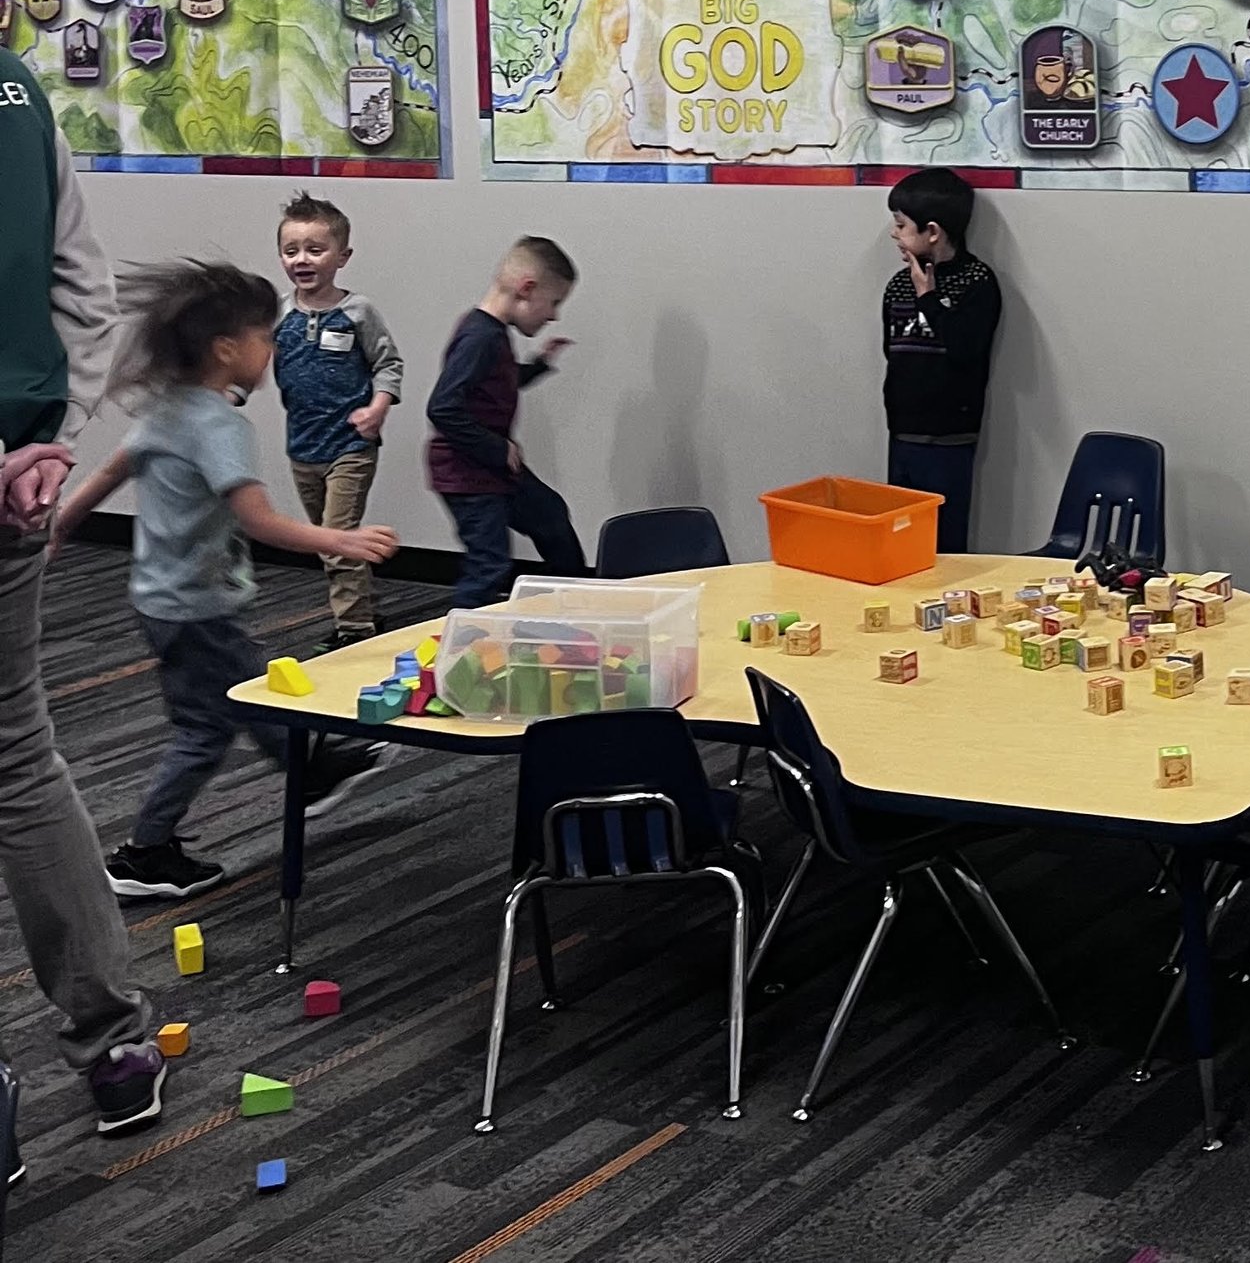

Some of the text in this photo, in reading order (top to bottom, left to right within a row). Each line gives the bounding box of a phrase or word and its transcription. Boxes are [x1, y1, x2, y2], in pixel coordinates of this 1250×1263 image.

[389, 22, 434, 69] 400
[659, 21, 805, 94] GOD
[495, 45, 543, 89] Years
[678, 98, 788, 133] STORY
[897, 93, 925, 104] PAUL
[1032, 118, 1090, 129] THE EARLY
[1038, 131, 1084, 142] CHURCH
